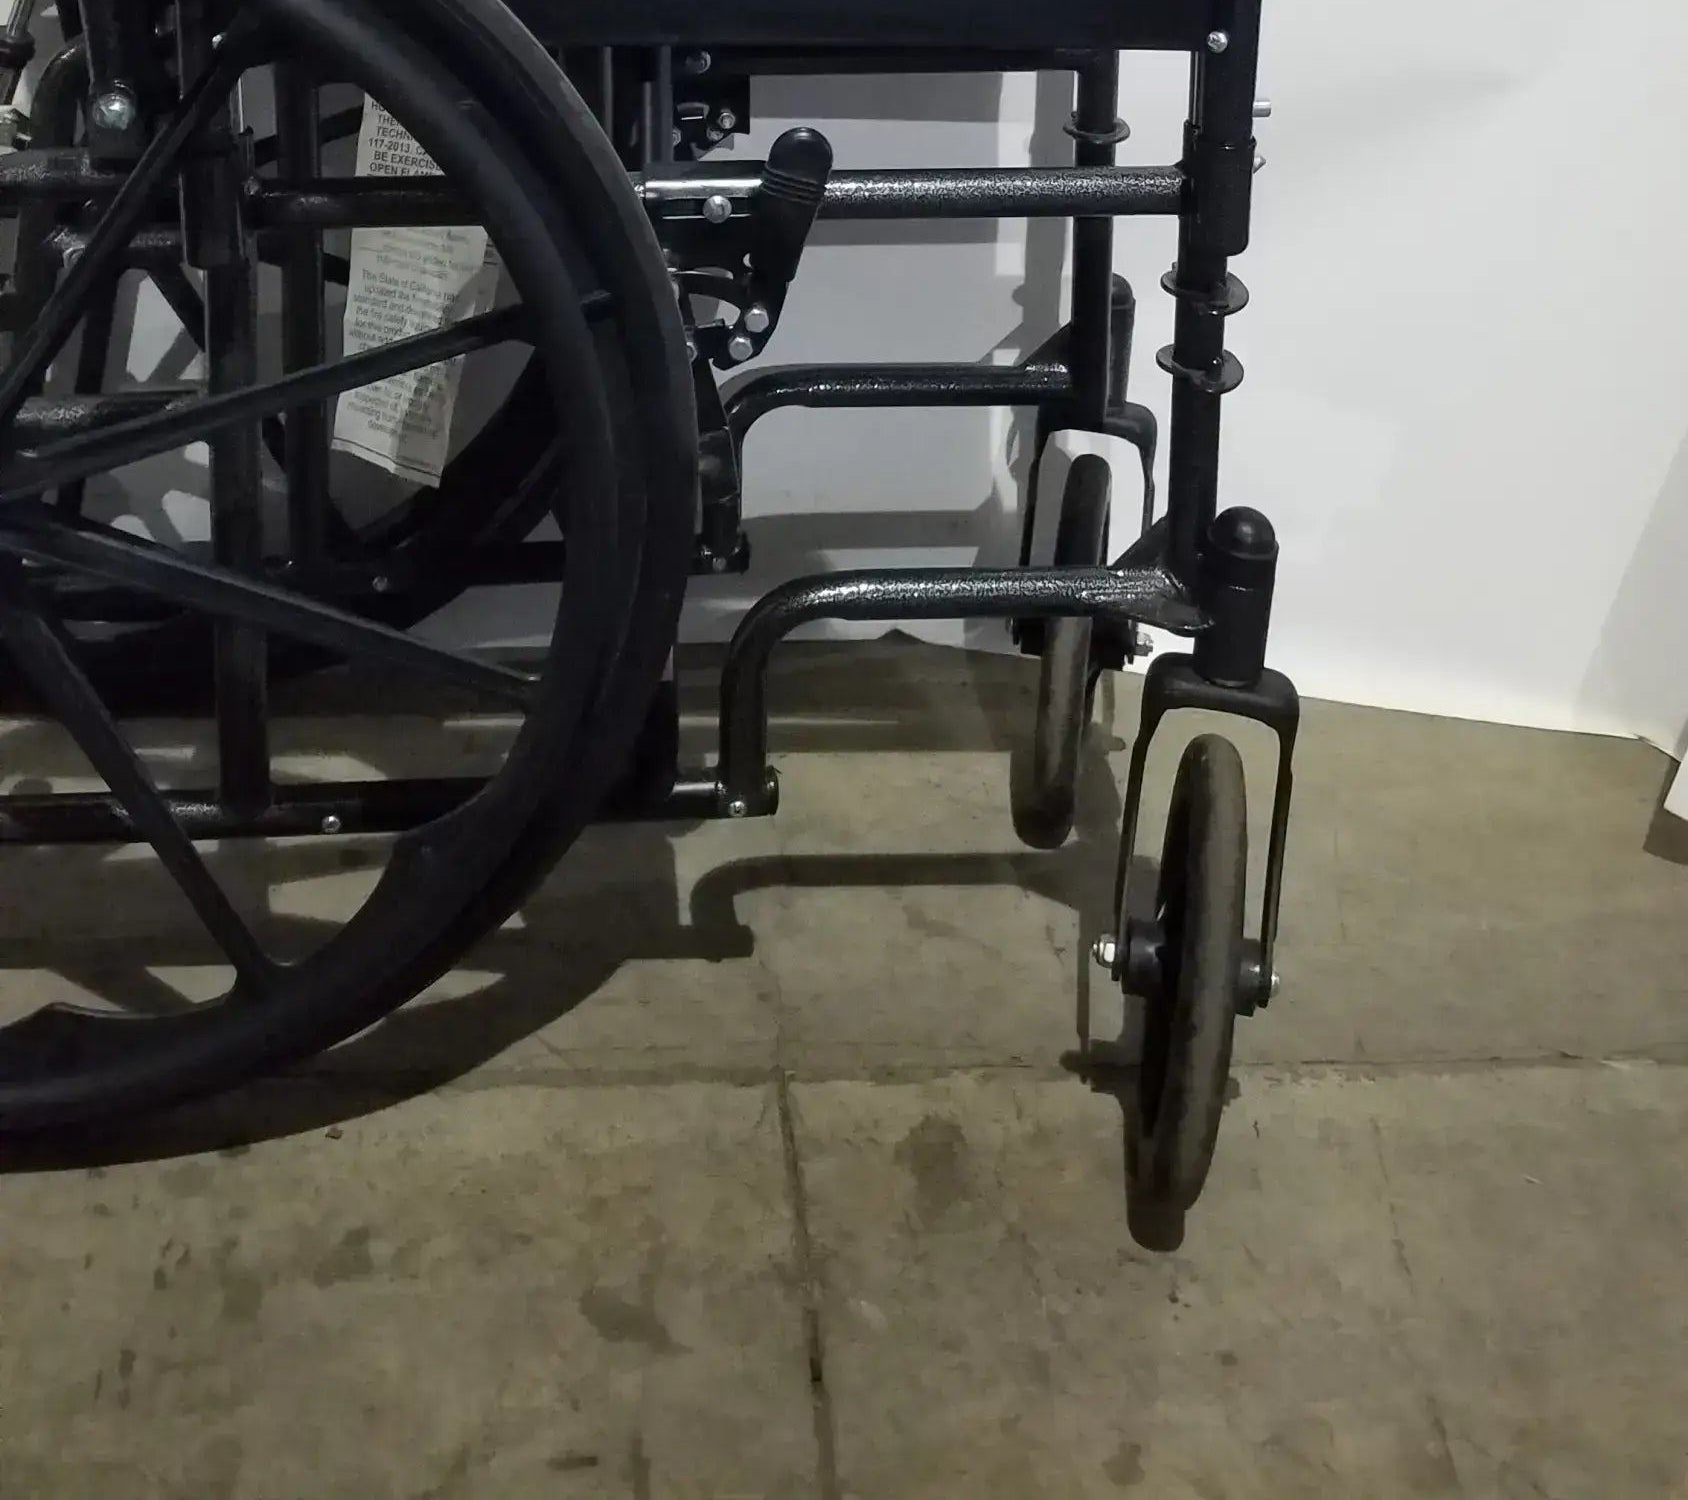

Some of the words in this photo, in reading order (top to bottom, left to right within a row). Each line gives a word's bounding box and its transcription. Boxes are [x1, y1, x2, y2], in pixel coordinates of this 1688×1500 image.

[377, 126, 412, 141] TECHN
[374, 150, 388, 162] BE
[370, 162, 397, 175] OPEN
